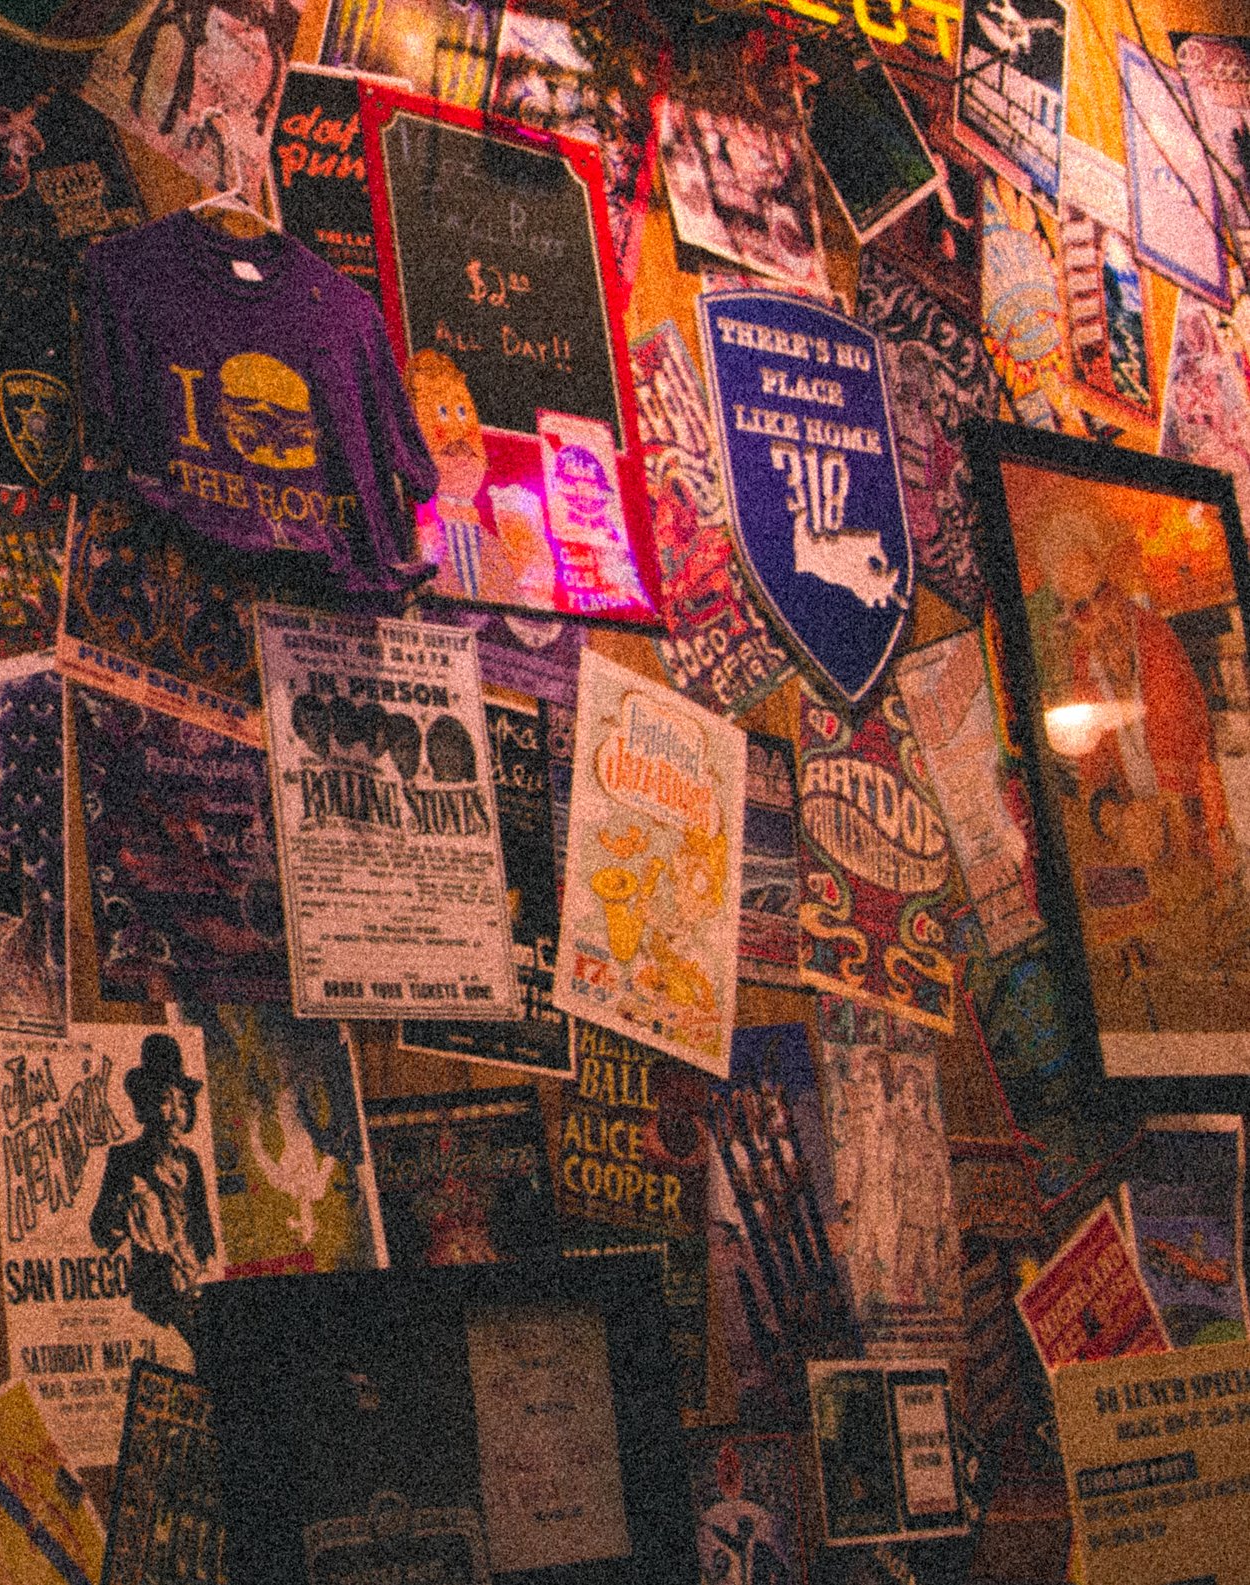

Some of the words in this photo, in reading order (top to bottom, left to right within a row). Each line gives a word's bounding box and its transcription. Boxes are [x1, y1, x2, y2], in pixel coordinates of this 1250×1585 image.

[715, 315, 831, 365] THERE'S
[833, 339, 872, 373] NO
[168, 361, 212, 452] I
[760, 366, 845, 408] PLACE
[732, 403, 802, 440] LIKE
[803, 415, 883, 456] HOME
[167, 459, 249, 511] THE
[769, 439, 851, 534] 318
[308, 671, 336, 694] IN
[348, 676, 450, 708] PERSON
[300, 766, 402, 830] ROLLING
[402, 783, 492, 838] STONES
[803, 757, 950, 858] RATDOG
[579, 1055, 659, 1111] BALL
[563, 1111, 645, 1161] ALICE
[563, 1153, 683, 1220] COOPER
[5, 1257, 53, 1303] SAN
[59, 1254, 132, 1301] DIEGO
[20, 1340, 94, 1375] SATURDAY
[101, 1338, 132, 1370] MAY
